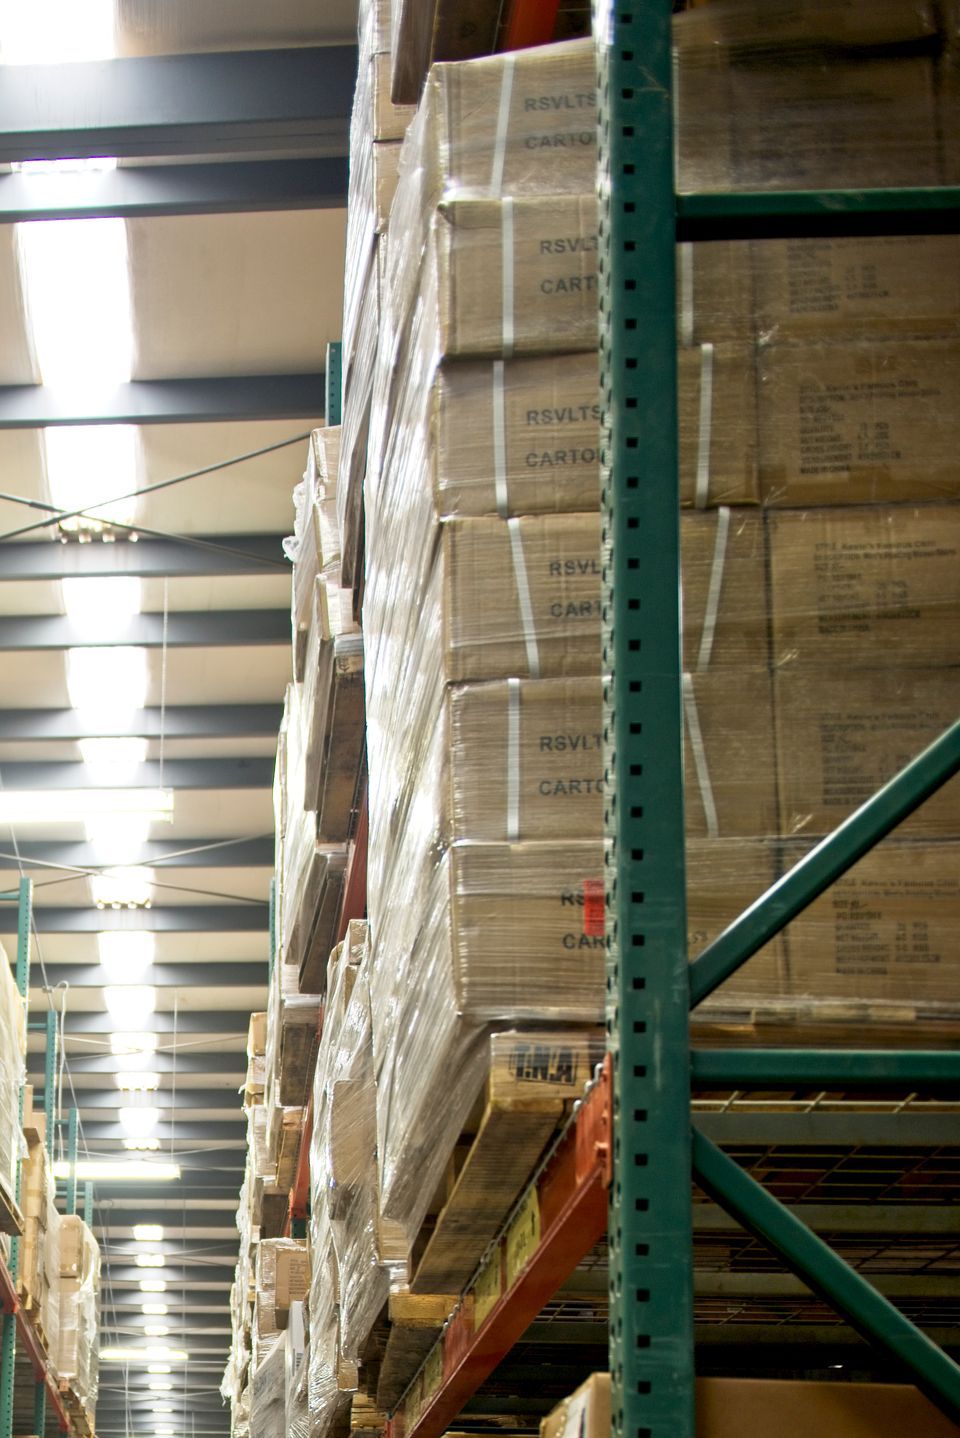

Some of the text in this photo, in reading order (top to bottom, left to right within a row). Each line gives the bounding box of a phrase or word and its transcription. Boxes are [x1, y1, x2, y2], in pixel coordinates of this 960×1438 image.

[525, 129, 597, 150] CARTO
[540, 276, 598, 294] CART
[526, 448, 600, 468] CARTO
